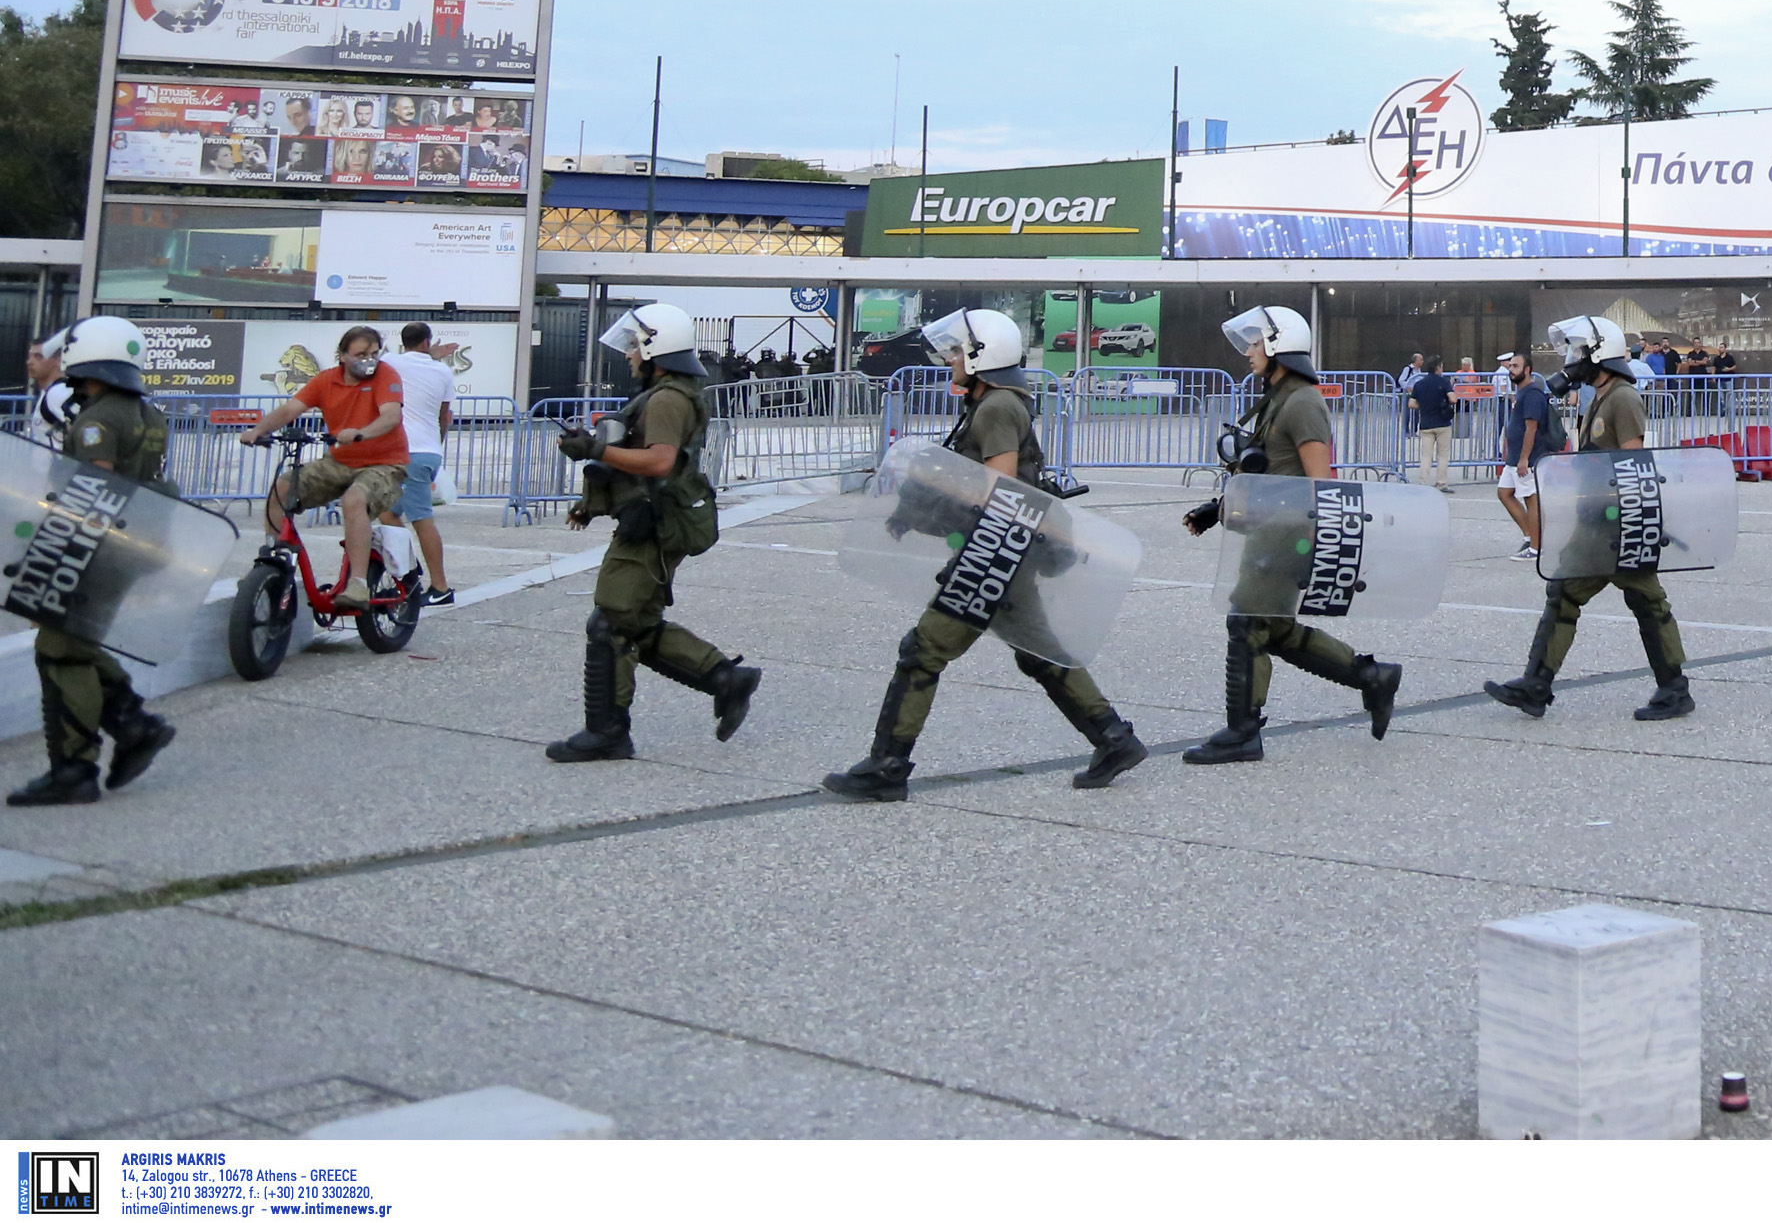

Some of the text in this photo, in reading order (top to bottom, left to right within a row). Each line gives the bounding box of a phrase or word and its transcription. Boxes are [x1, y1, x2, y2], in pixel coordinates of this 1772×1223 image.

[236, 27, 257, 39] fair
[237, 9, 312, 24] thessaloniki
[244, 20, 320, 34] international
[339, 51, 394, 63] tif.helexpo.gr
[496, 61, 531, 70] HELEXPO
[159, 87, 197, 97] music
[1376, 104, 1467, 170] ΔΕΗ
[469, 173, 519, 183] Brothers
[1632, 151, 1754, 185] Πάντα
[910, 187, 1116, 234] Europcar
[438, 232, 491, 241] Everywhere
[146, 334, 212, 352] ολογικό
[1613, 457, 1643, 569] ΑΣΤΥΝΟΜΙΑ
[1636, 462, 1661, 563] POLICE
[12, 474, 107, 611] ΑΣΤΥΝΟΜΙΑ
[42, 488, 128, 615] POLICE
[938, 487, 1025, 616] ΑΣΤΥΝΟΜΙΑ
[967, 503, 1044, 620] POLICE
[1303, 487, 1342, 610] ΑΣΤΥΝΟΜΙΑ
[1329, 494, 1362, 606] POLICE
